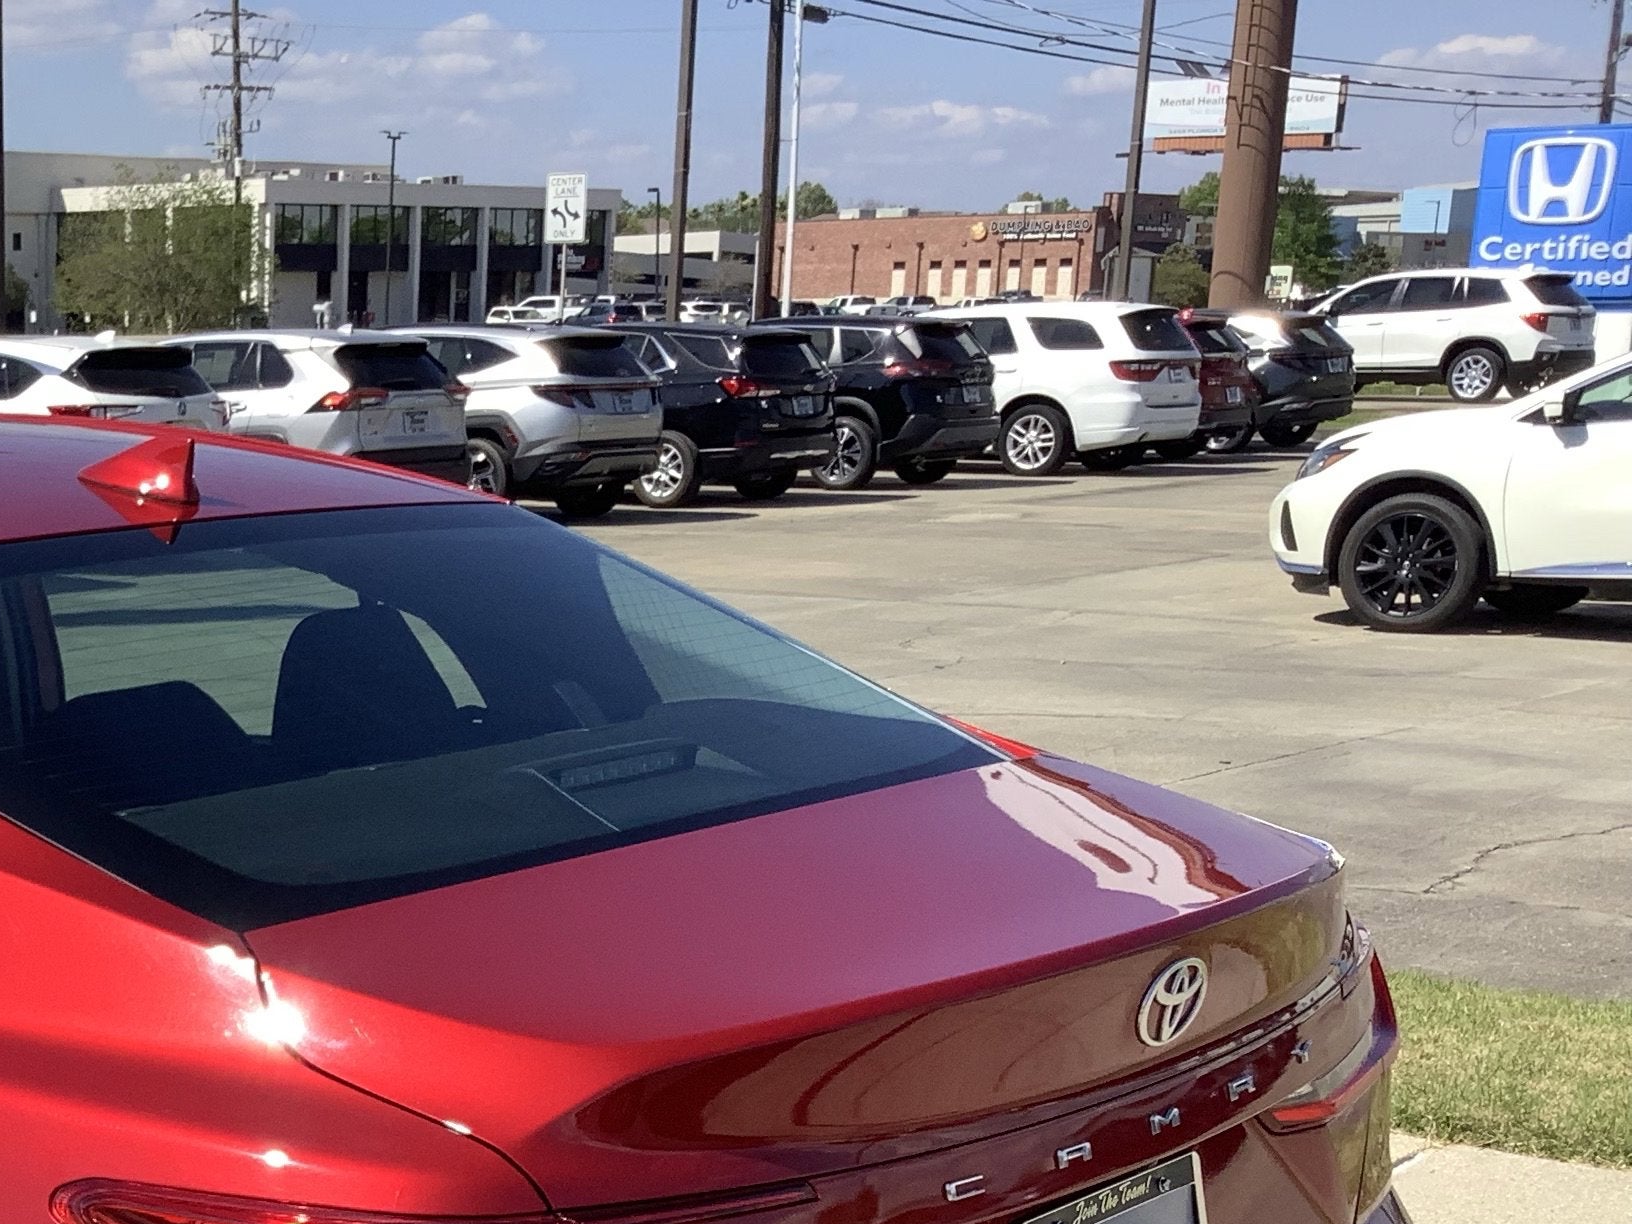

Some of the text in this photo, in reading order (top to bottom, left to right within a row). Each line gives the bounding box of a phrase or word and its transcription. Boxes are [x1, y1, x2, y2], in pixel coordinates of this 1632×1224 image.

[1160, 97, 1195, 107] Mental
[1197, 96, 1225, 105] Healt
[1305, 93, 1326, 102] Use
[550, 176, 583, 187] CENTER
[555, 187, 578, 196] LANE
[991, 220, 1052, 232] DUMPLING
[1066, 219, 1091, 231] BAO
[552, 229, 576, 239] ONLY
[1478, 233, 1632, 261] Certified
[944, 1039, 1313, 1202] CAMRY
[1099, 1187, 1119, 1213] The
[1119, 1175, 1152, 1203] Team!
